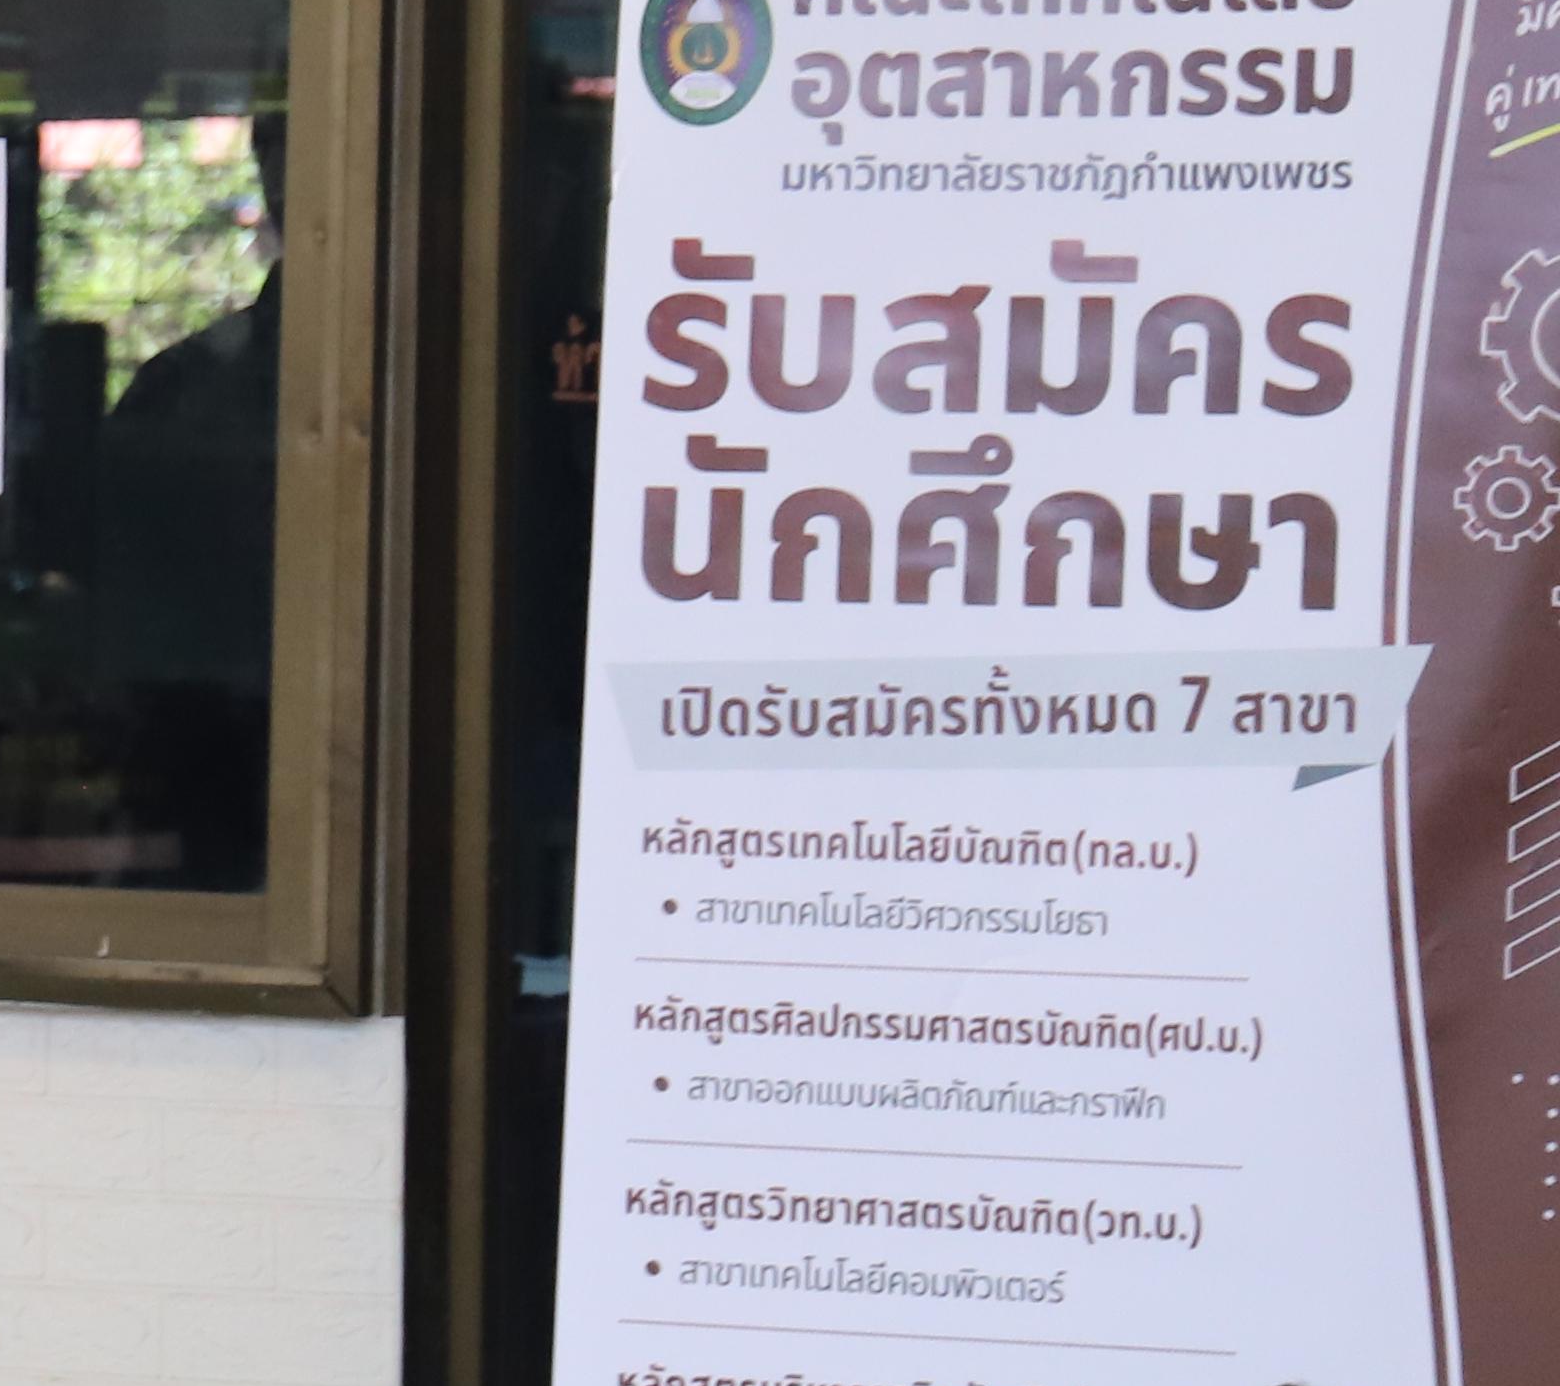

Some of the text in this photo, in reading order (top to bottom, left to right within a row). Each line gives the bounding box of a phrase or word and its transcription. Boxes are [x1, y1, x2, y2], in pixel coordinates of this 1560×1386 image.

[790, 44, 1355, 146] อุตสาหกรรม
[1485, 63, 1515, 133] คู่
[781, 151, 1353, 201] มหาวิทยาลัยราชภัฏกำแพงเพชร
[642, 237, 1355, 417] รับสมัคร
[640, 433, 1339, 613] นักศึกษา
[659, 665, 1359, 741] เปิดรับสมัครทั้งหมด 7 สาขา
[640, 817, 1200, 879] หลักสูตรเทคโนโลยีบัณฑิต(ทล.บ.)
[694, 891, 1110, 939] สาขาเทคโนโลยีวิศวกรรมโยธา
[633, 996, 1263, 1062] หลักสูตรศิลปกรรมศาสตรบัณฑิต(ศป.บ.)
[624, 1181, 1203, 1250] หลักสูตรวิทยาศาสตรบัณฑิต(วท.บ.)
[678, 1254, 1068, 1307] สาขาเทคโนโลยีคอมพิวเตอร์
